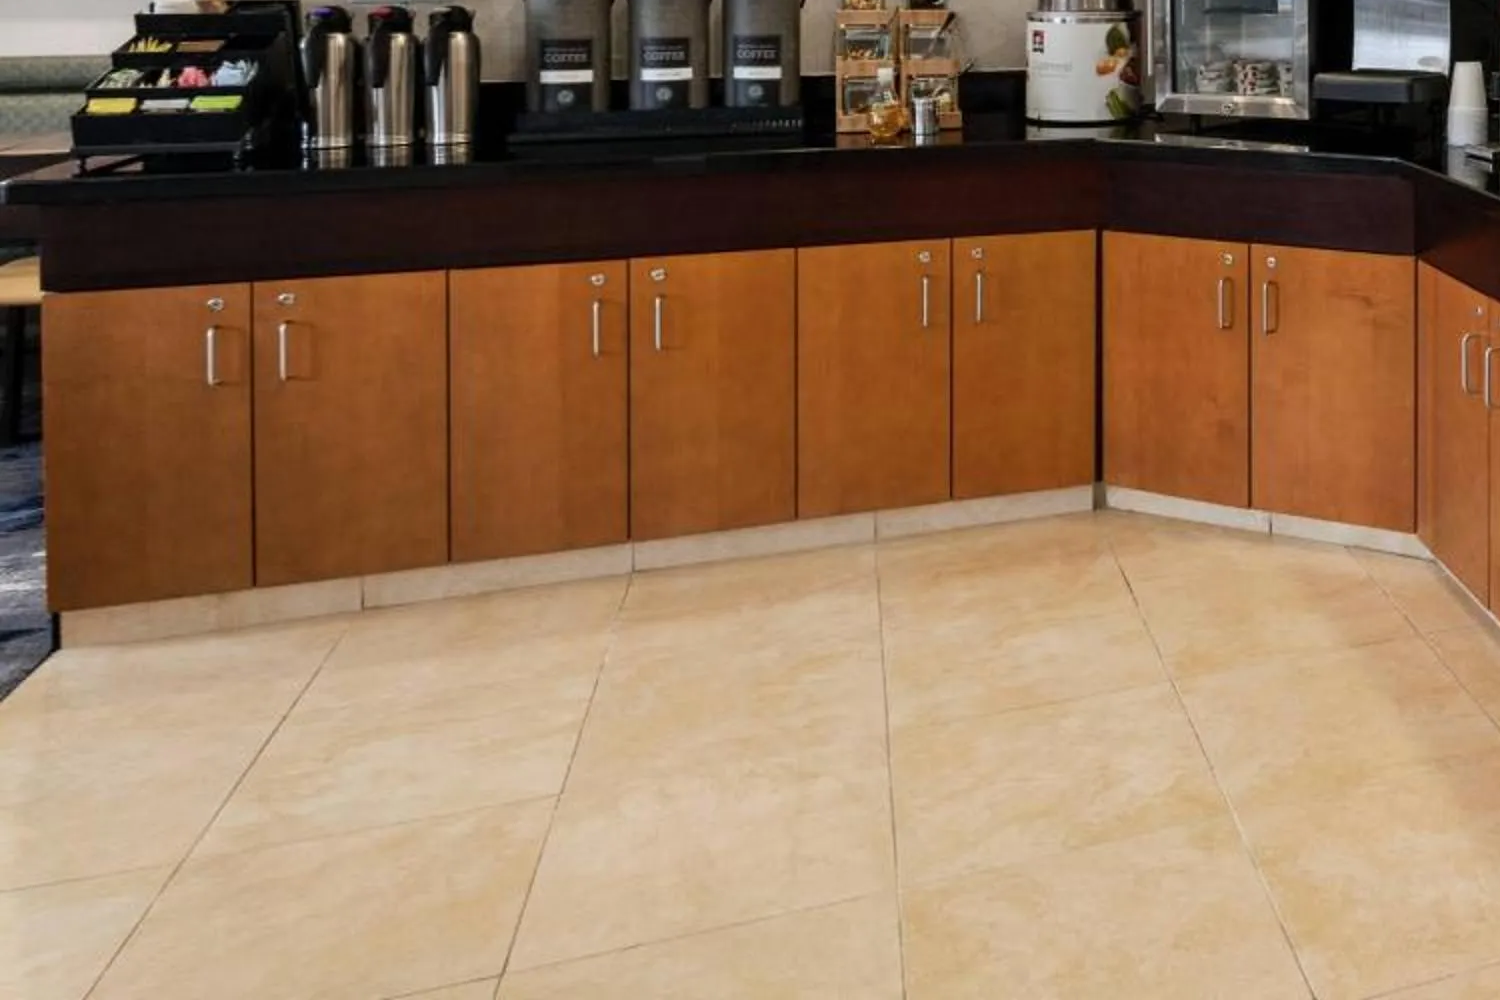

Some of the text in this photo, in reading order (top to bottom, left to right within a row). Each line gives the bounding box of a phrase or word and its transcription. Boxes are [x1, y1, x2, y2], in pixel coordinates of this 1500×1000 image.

[543, 53, 588, 63] COFFEE
[643, 51, 685, 61] COFFEE
[736, 49, 777, 59] COFFEE
